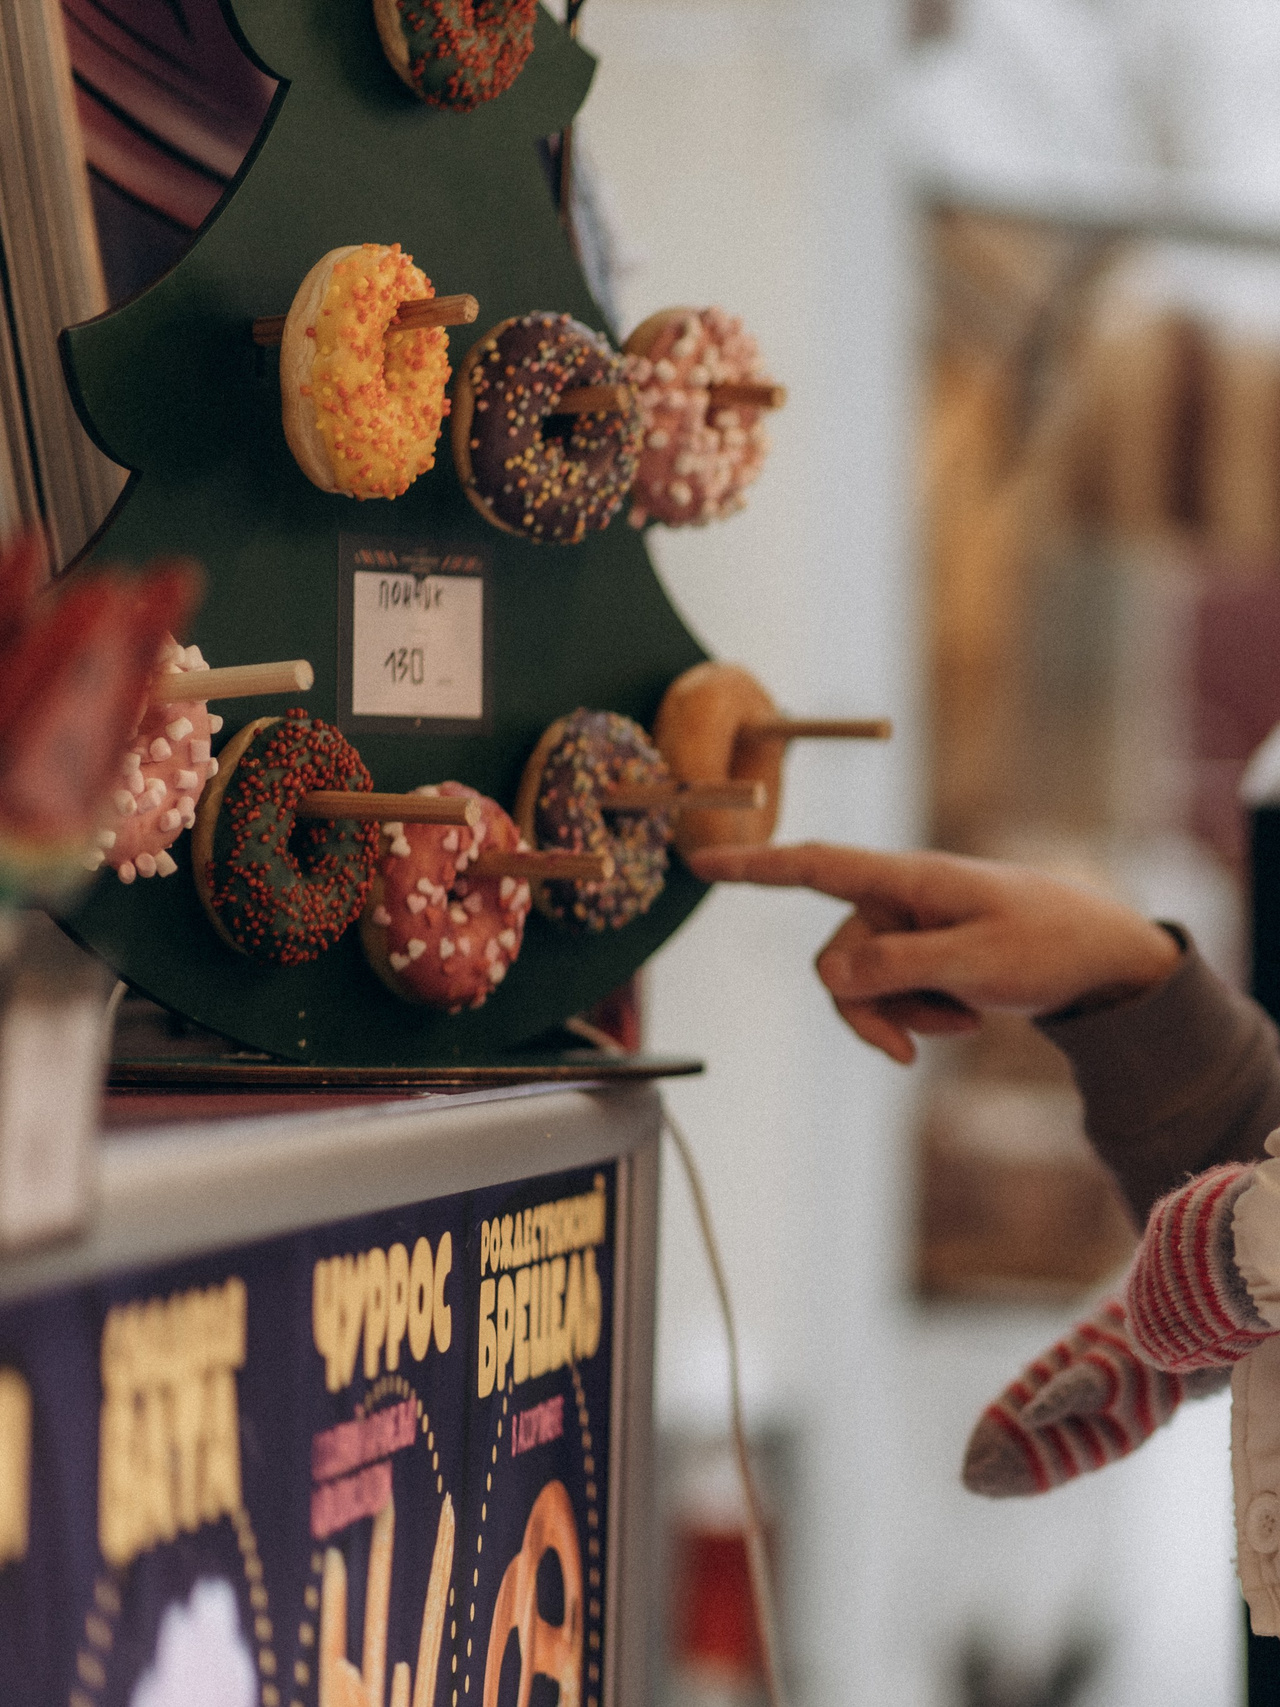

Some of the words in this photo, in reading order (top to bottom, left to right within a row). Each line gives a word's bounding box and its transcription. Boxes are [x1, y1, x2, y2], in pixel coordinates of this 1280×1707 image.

[384, 647, 425, 686] 130
[479, 1172, 606, 1277] РОЖДЕСТ
[313, 1231, 452, 1394] ЧУРРОС
